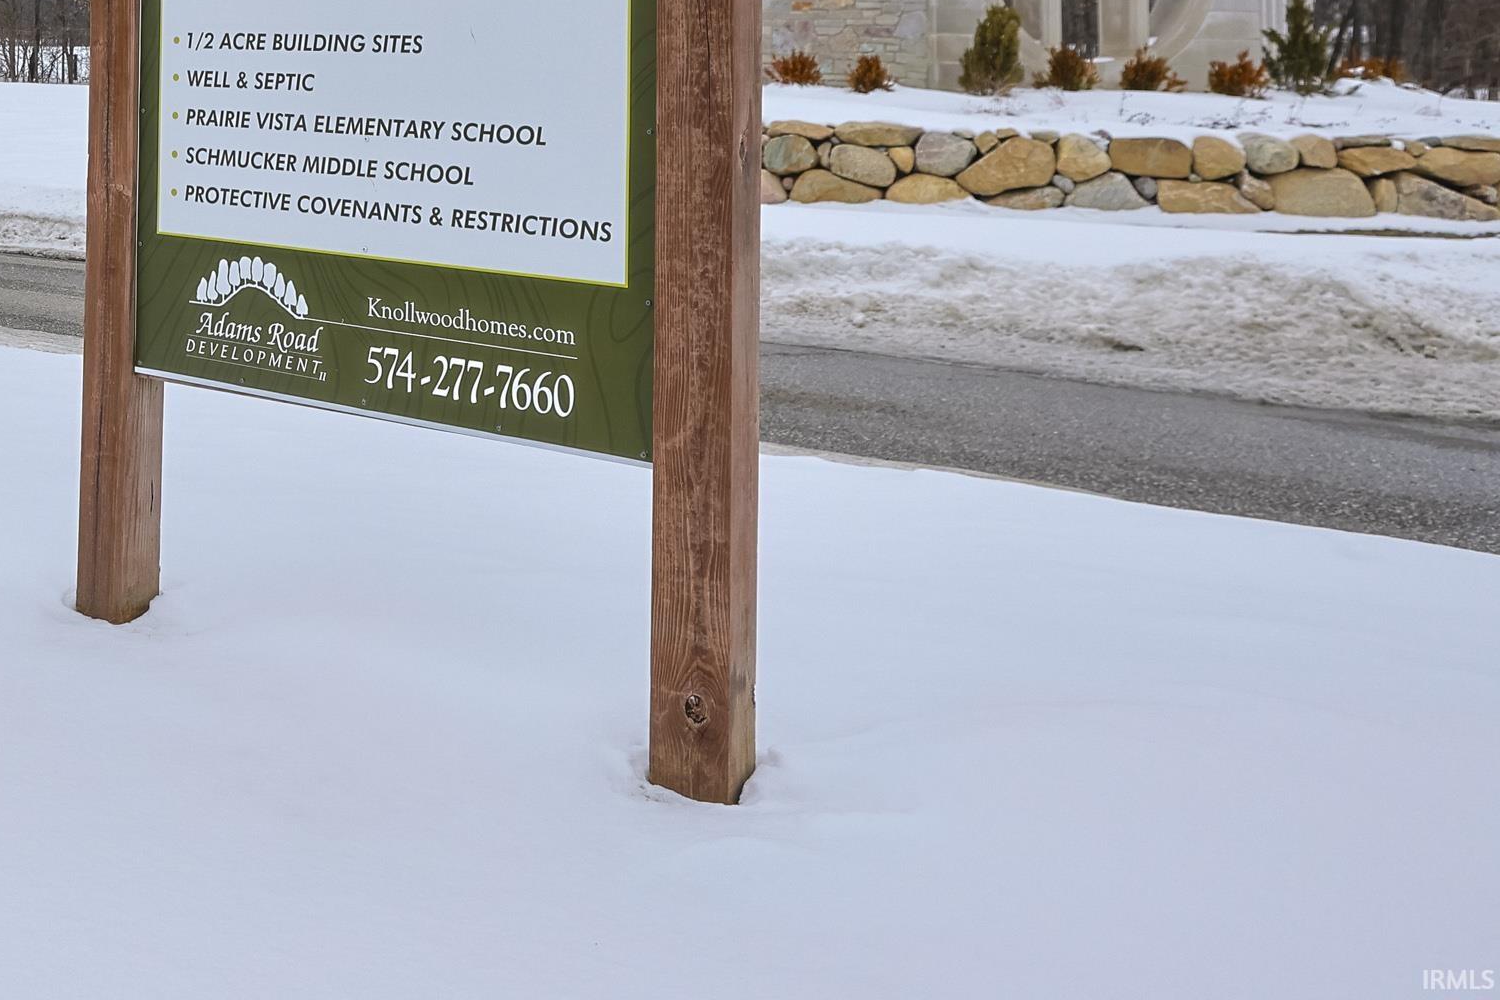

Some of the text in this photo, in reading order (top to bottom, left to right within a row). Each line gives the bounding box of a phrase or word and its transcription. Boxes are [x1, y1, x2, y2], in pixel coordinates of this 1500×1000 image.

[186, 32, 423, 54] 1/2 ACRE BUILDING SITES
[187, 70, 314, 92] WELL & SEPTIC
[186, 109, 546, 146] PRAIRIE VISTA ELEMENTARY SCHOOL
[185, 147, 474, 186] SCHMUCKER MIDDLE SCHOOL
[184, 186, 612, 242] PROTECTIVE COVENANTS & RESTRICTIONS
[196, 312, 323, 353] Adams Road
[367, 298, 575, 345] Knollwoodhomes.com
[186, 339, 322, 374] DEVELOPMENT
[364, 346, 575, 417] 574-277-7660
